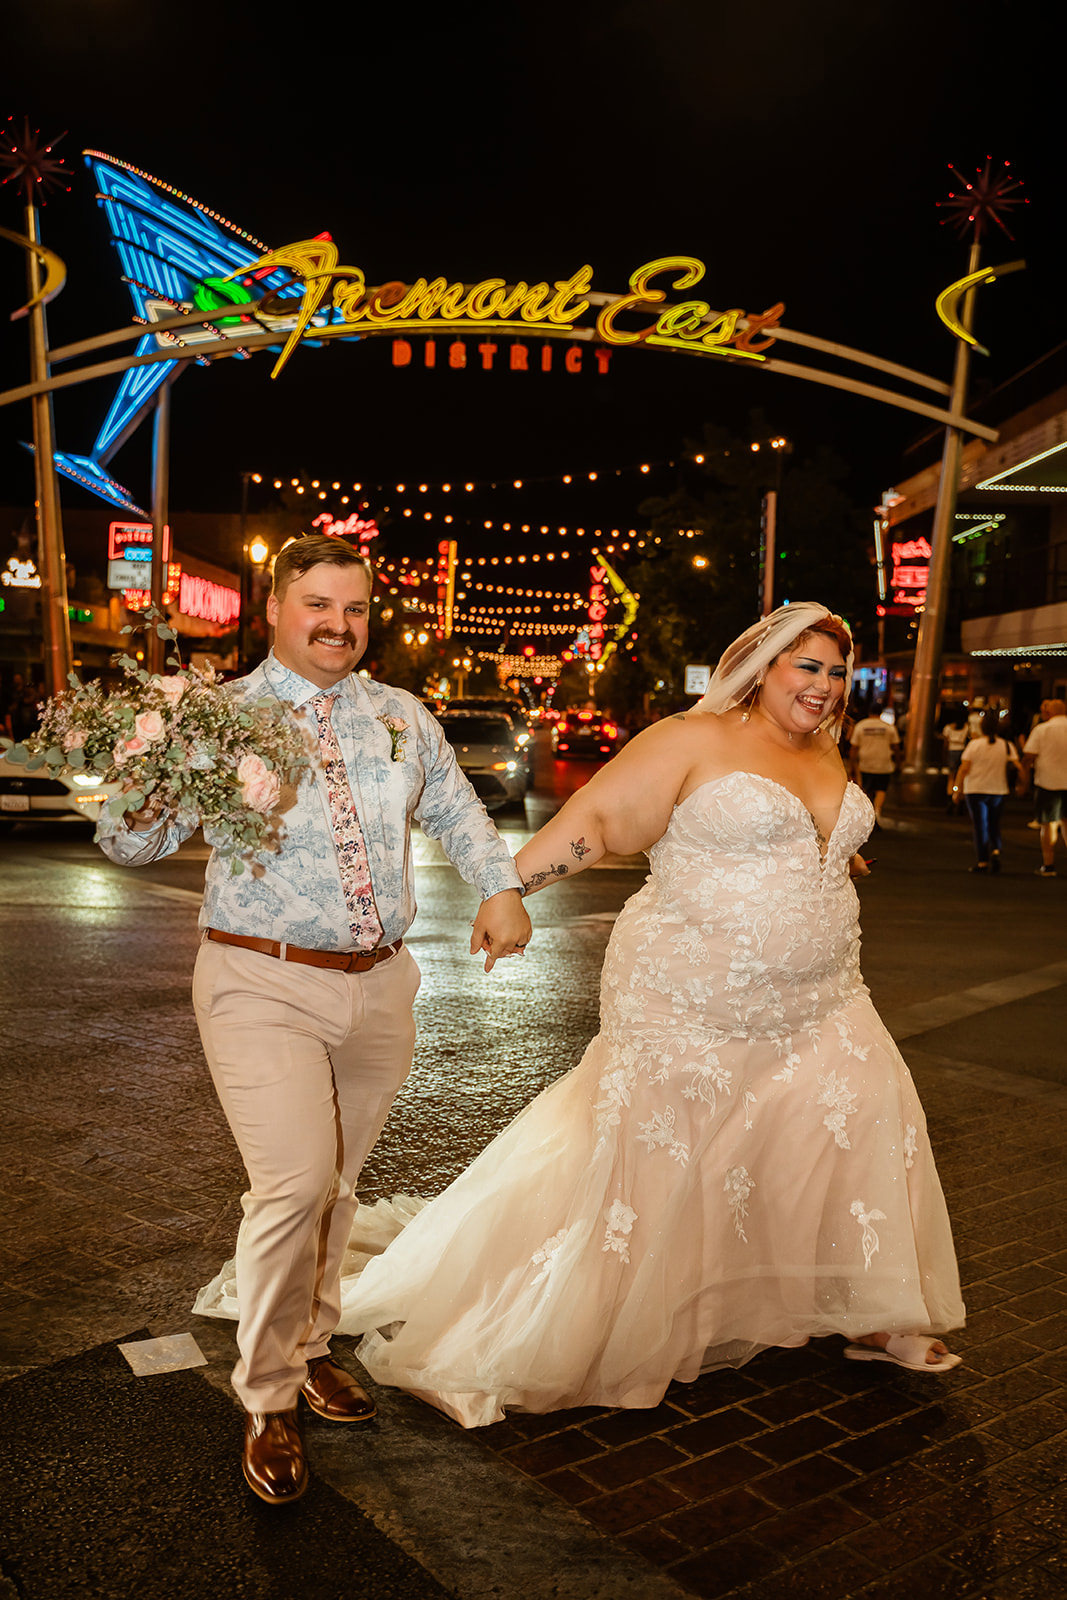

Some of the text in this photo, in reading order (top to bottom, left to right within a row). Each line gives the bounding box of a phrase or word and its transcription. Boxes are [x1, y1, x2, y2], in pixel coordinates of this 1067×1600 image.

[222, 239, 786, 379] Fremont East
[391, 339, 613, 375] DISTRICT
